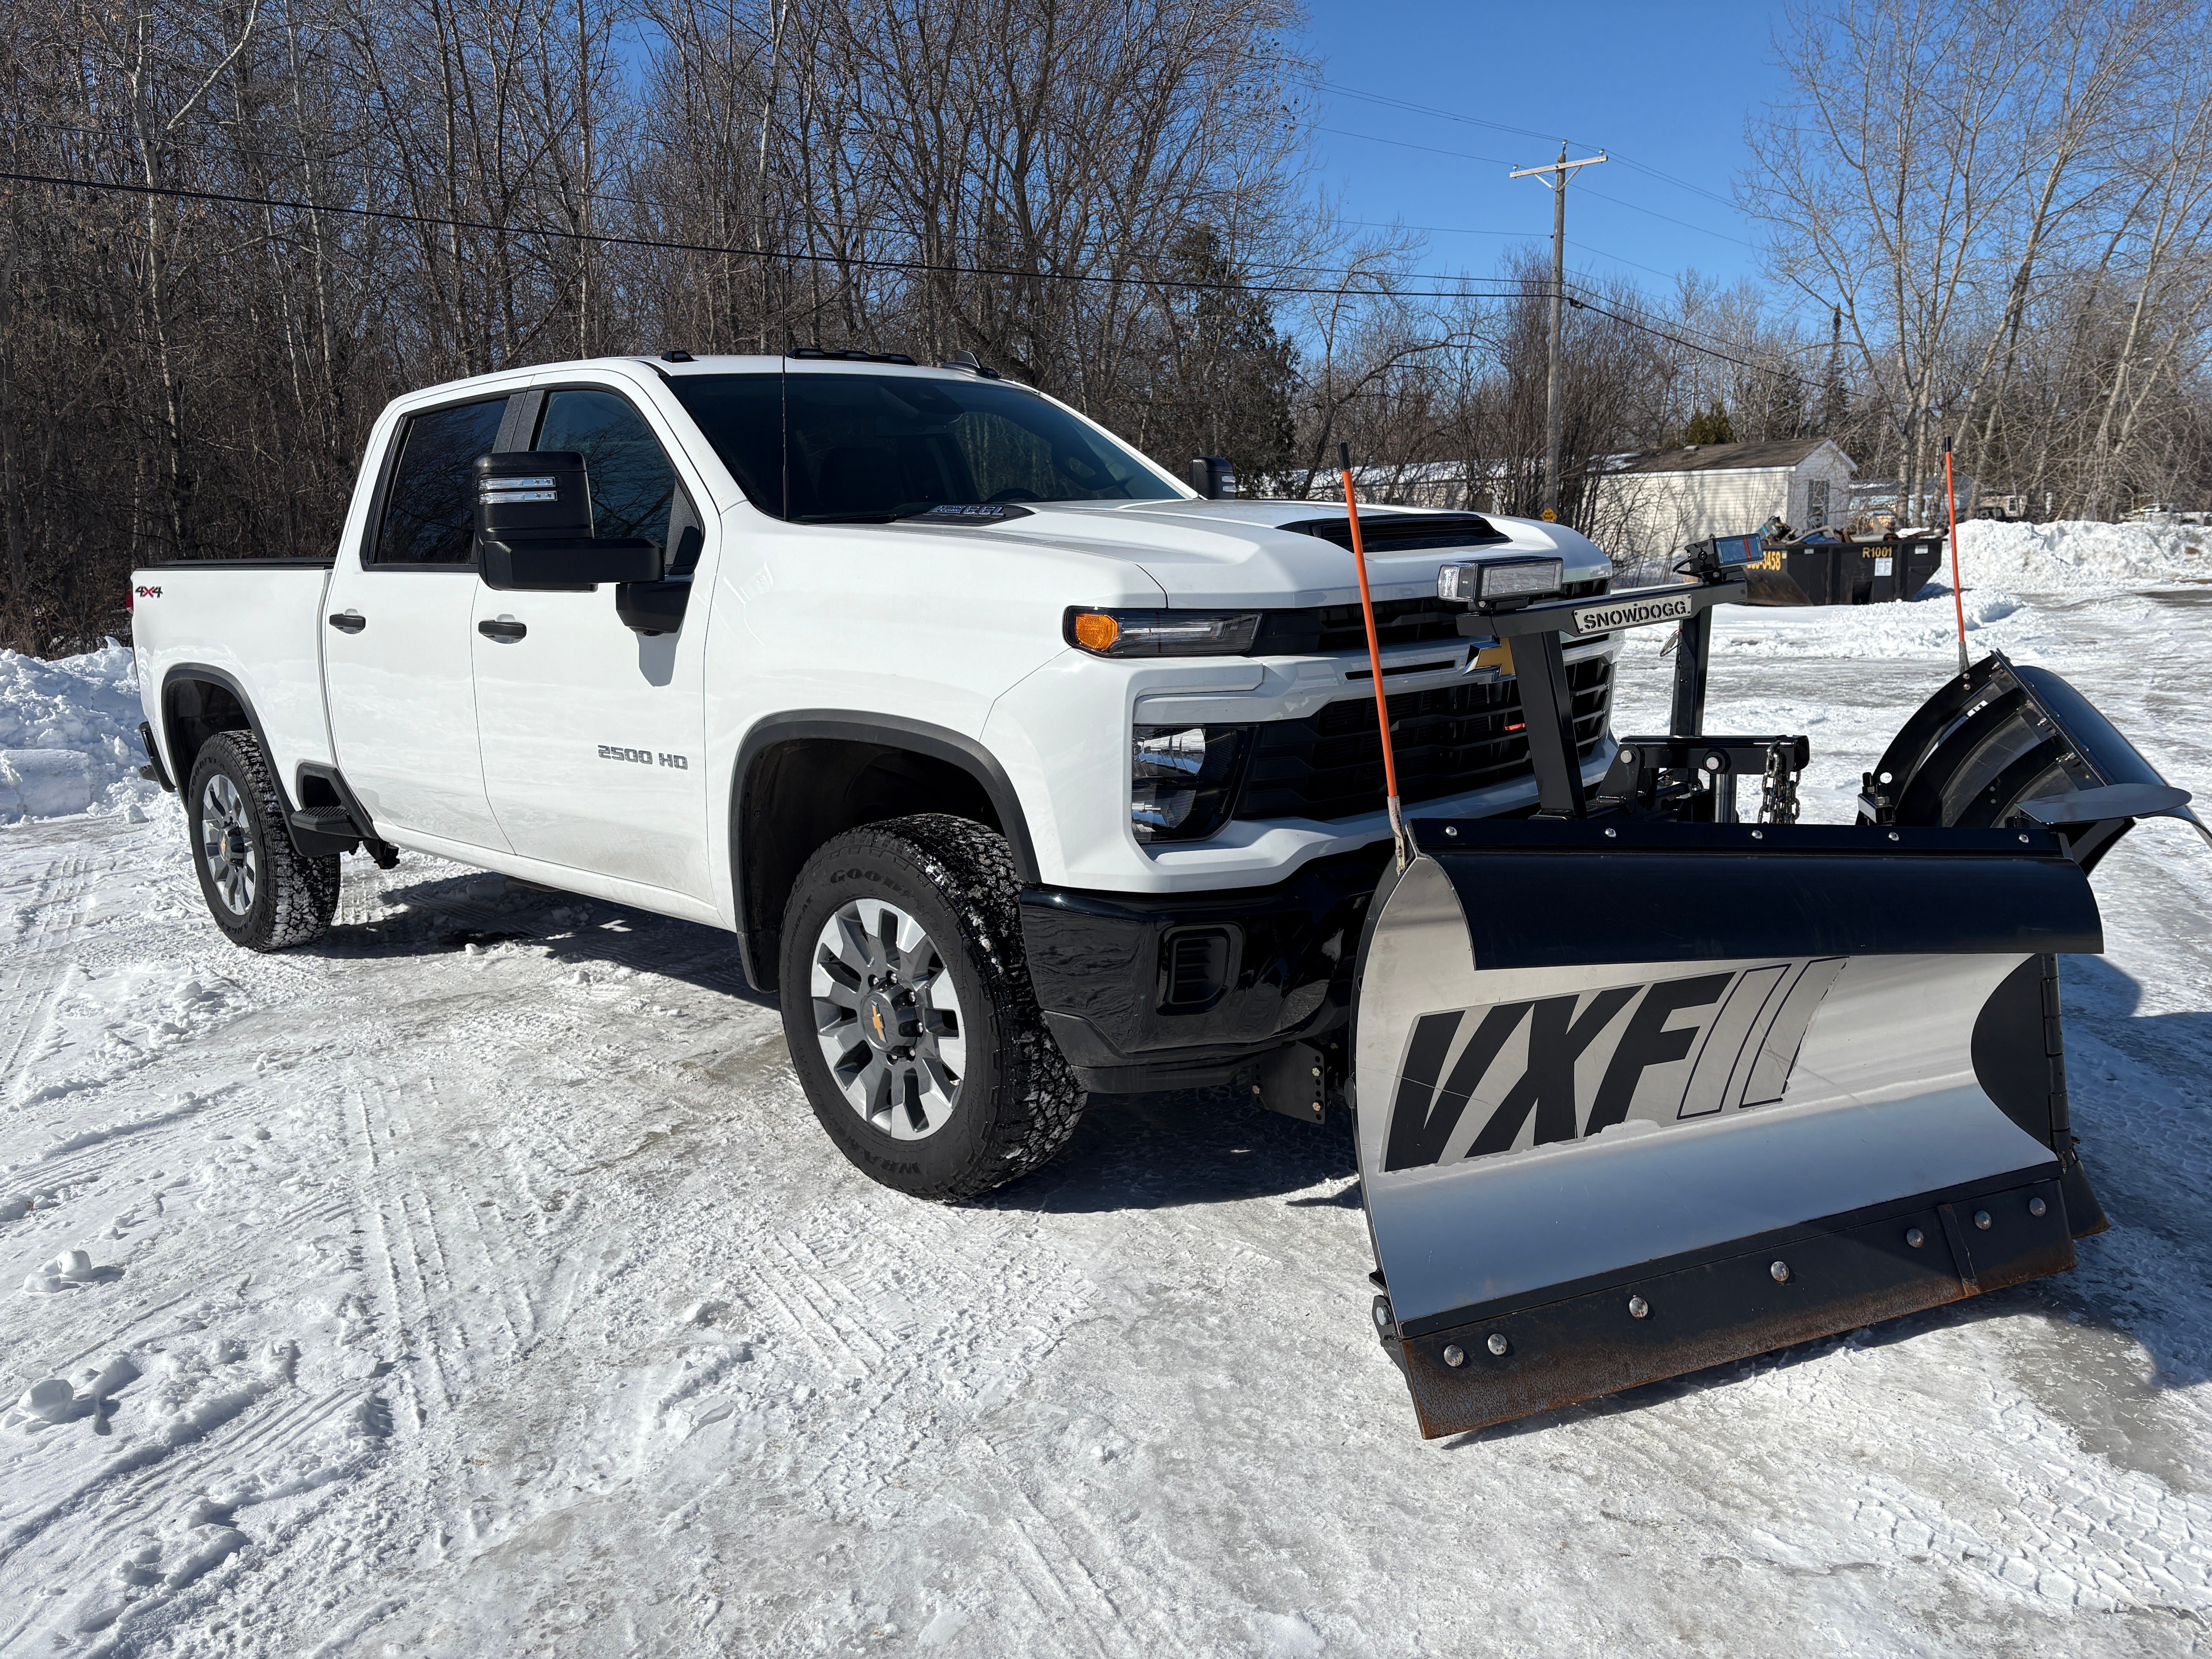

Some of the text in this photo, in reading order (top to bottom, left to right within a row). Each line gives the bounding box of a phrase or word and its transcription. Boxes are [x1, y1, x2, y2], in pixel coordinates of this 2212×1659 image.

[1747, 551, 1781, 571] -3458
[1863, 546, 1893, 558] R1001
[1584, 601, 1686, 629] SNOWDOGG
[598, 745, 688, 770] 2500 HD
[1384, 971, 1736, 1173] VXF
